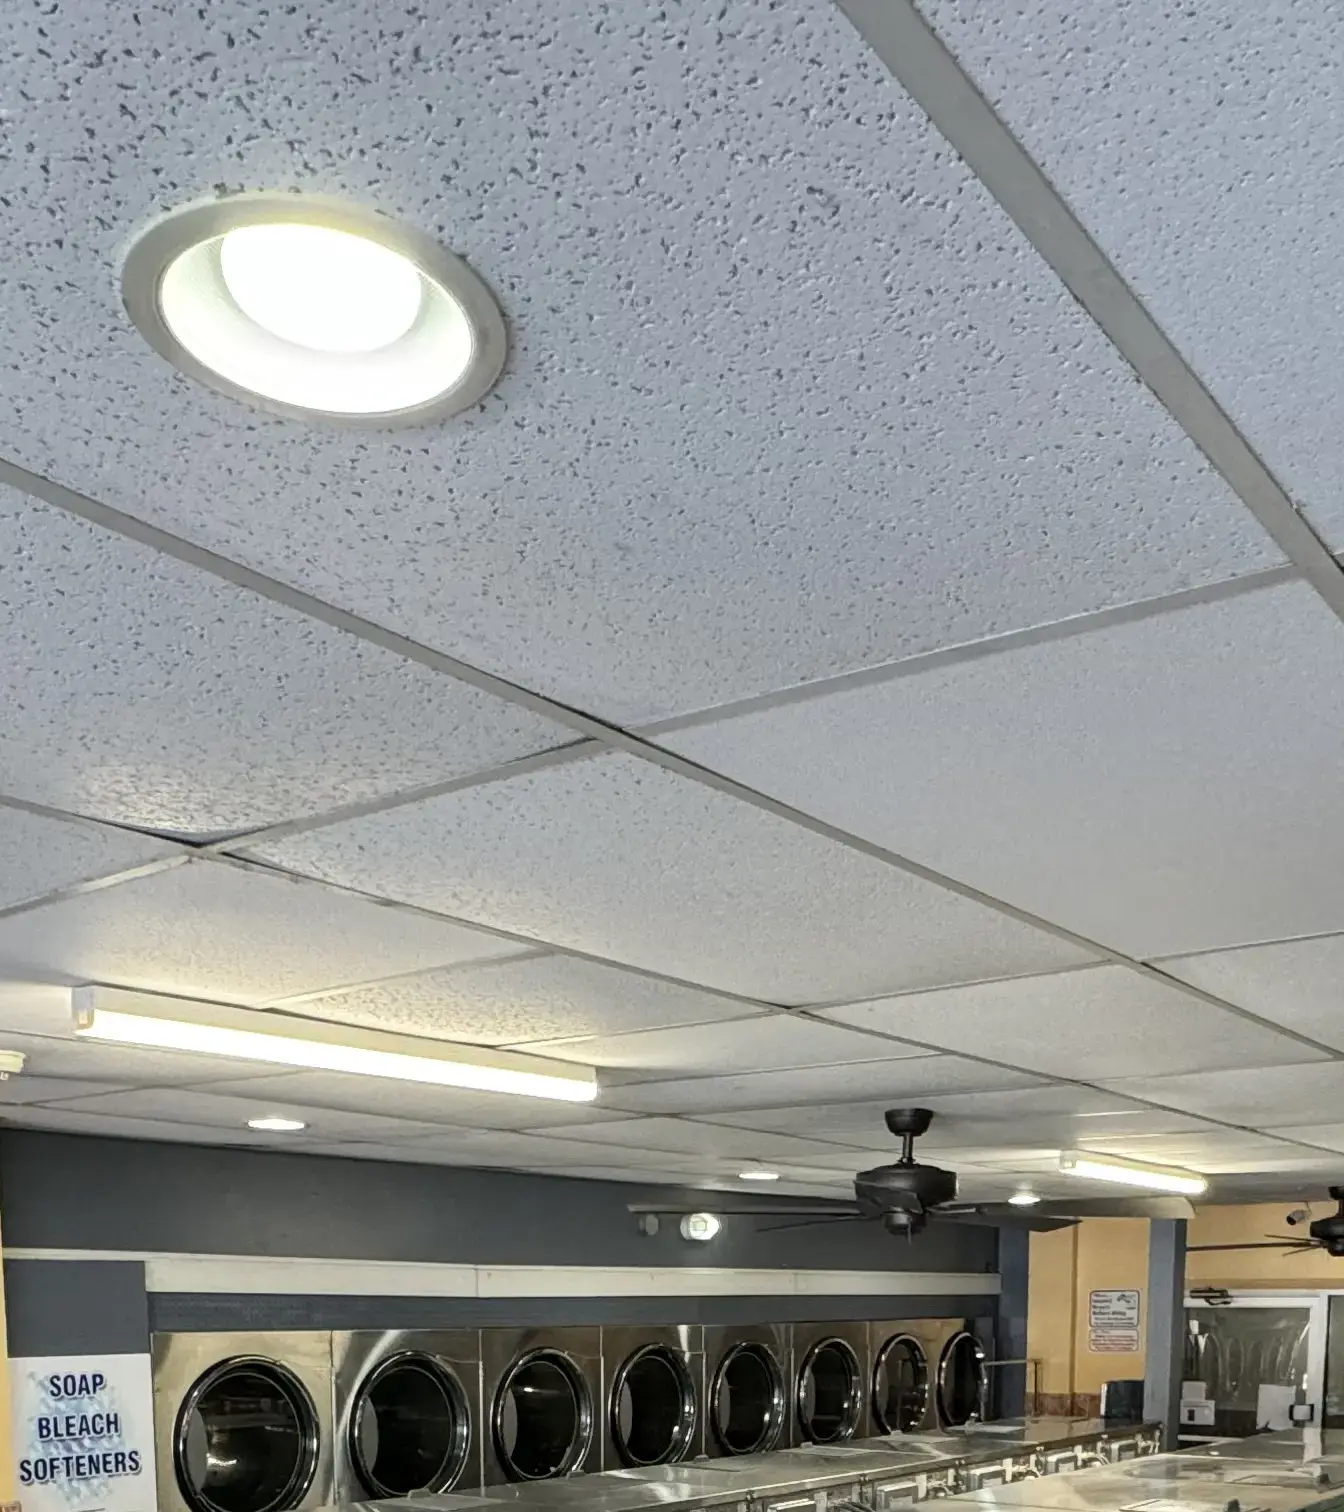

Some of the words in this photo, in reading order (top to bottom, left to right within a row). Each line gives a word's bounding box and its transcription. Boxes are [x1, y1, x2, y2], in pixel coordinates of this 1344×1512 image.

[50, 1374, 104, 1397] SOAP
[38, 1413, 120, 1440] BLEACH
[20, 1451, 141, 1483] SOFTENERS
